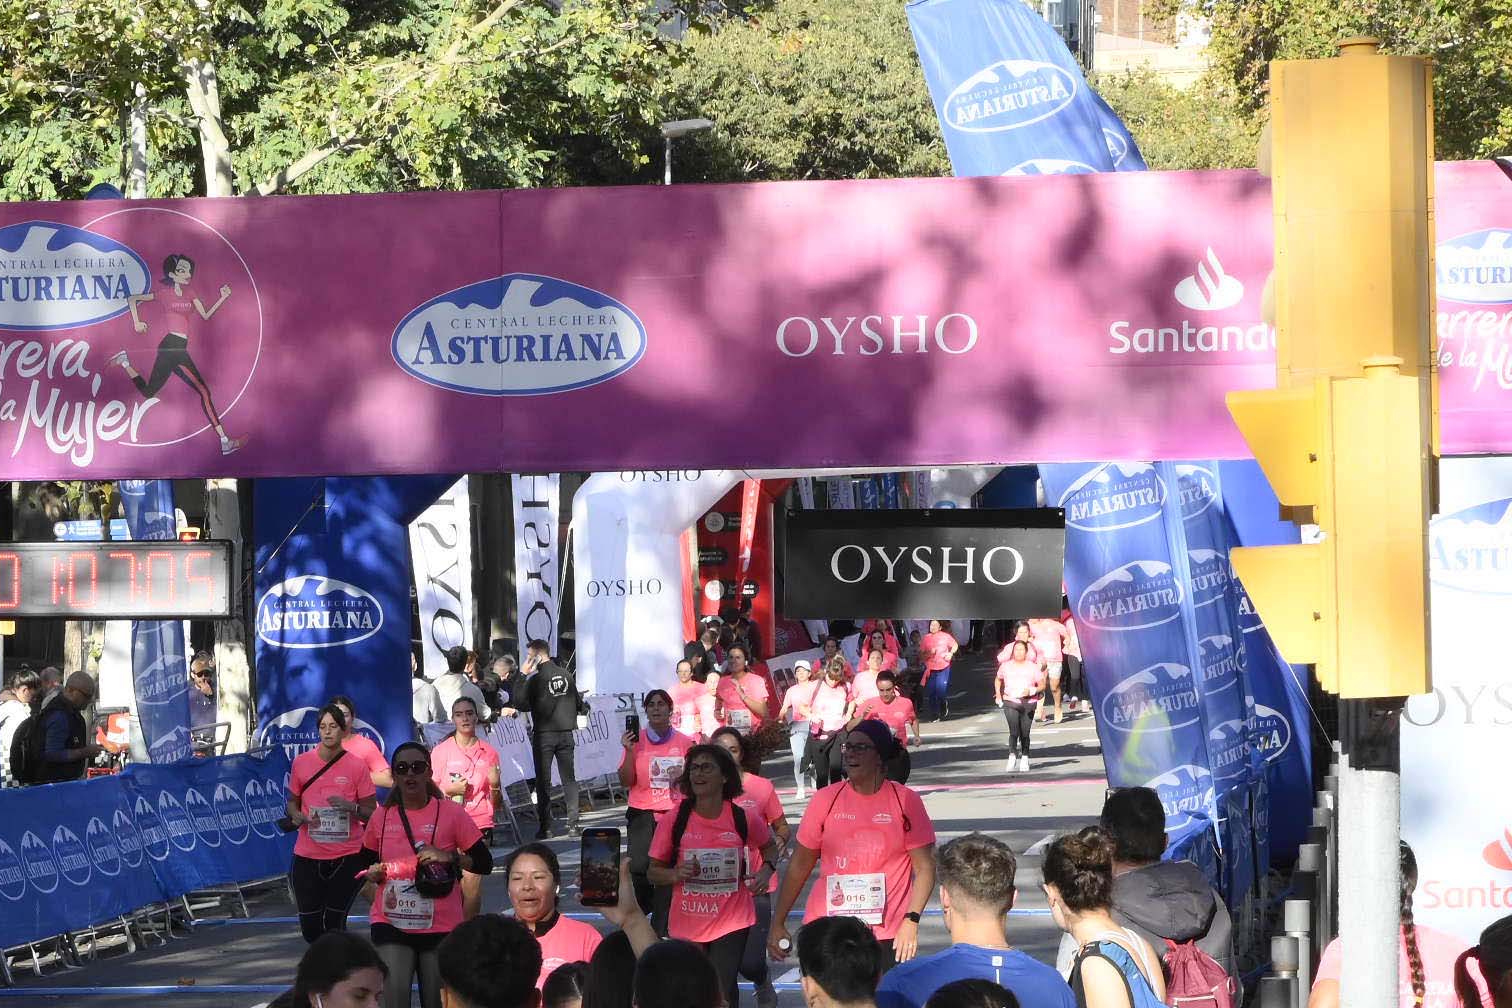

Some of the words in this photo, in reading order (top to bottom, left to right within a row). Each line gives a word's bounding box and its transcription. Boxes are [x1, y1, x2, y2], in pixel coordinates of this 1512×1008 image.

[54, 257, 126, 269] LECHERA
[450, 316, 529, 329] CENTRAL
[537, 314, 618, 327] LECHERA
[411, 321, 626, 365] ASTURIANA
[775, 313, 979, 357] OYSHO
[11, 374, 161, 468] Mujer
[620, 470, 702, 483] OYSHO
[831, 544, 1023, 585] OYSHO
[586, 578, 662, 598] OYSHO
[261, 605, 374, 632] ASTURIANA
[681, 901, 719, 913] SUMA
